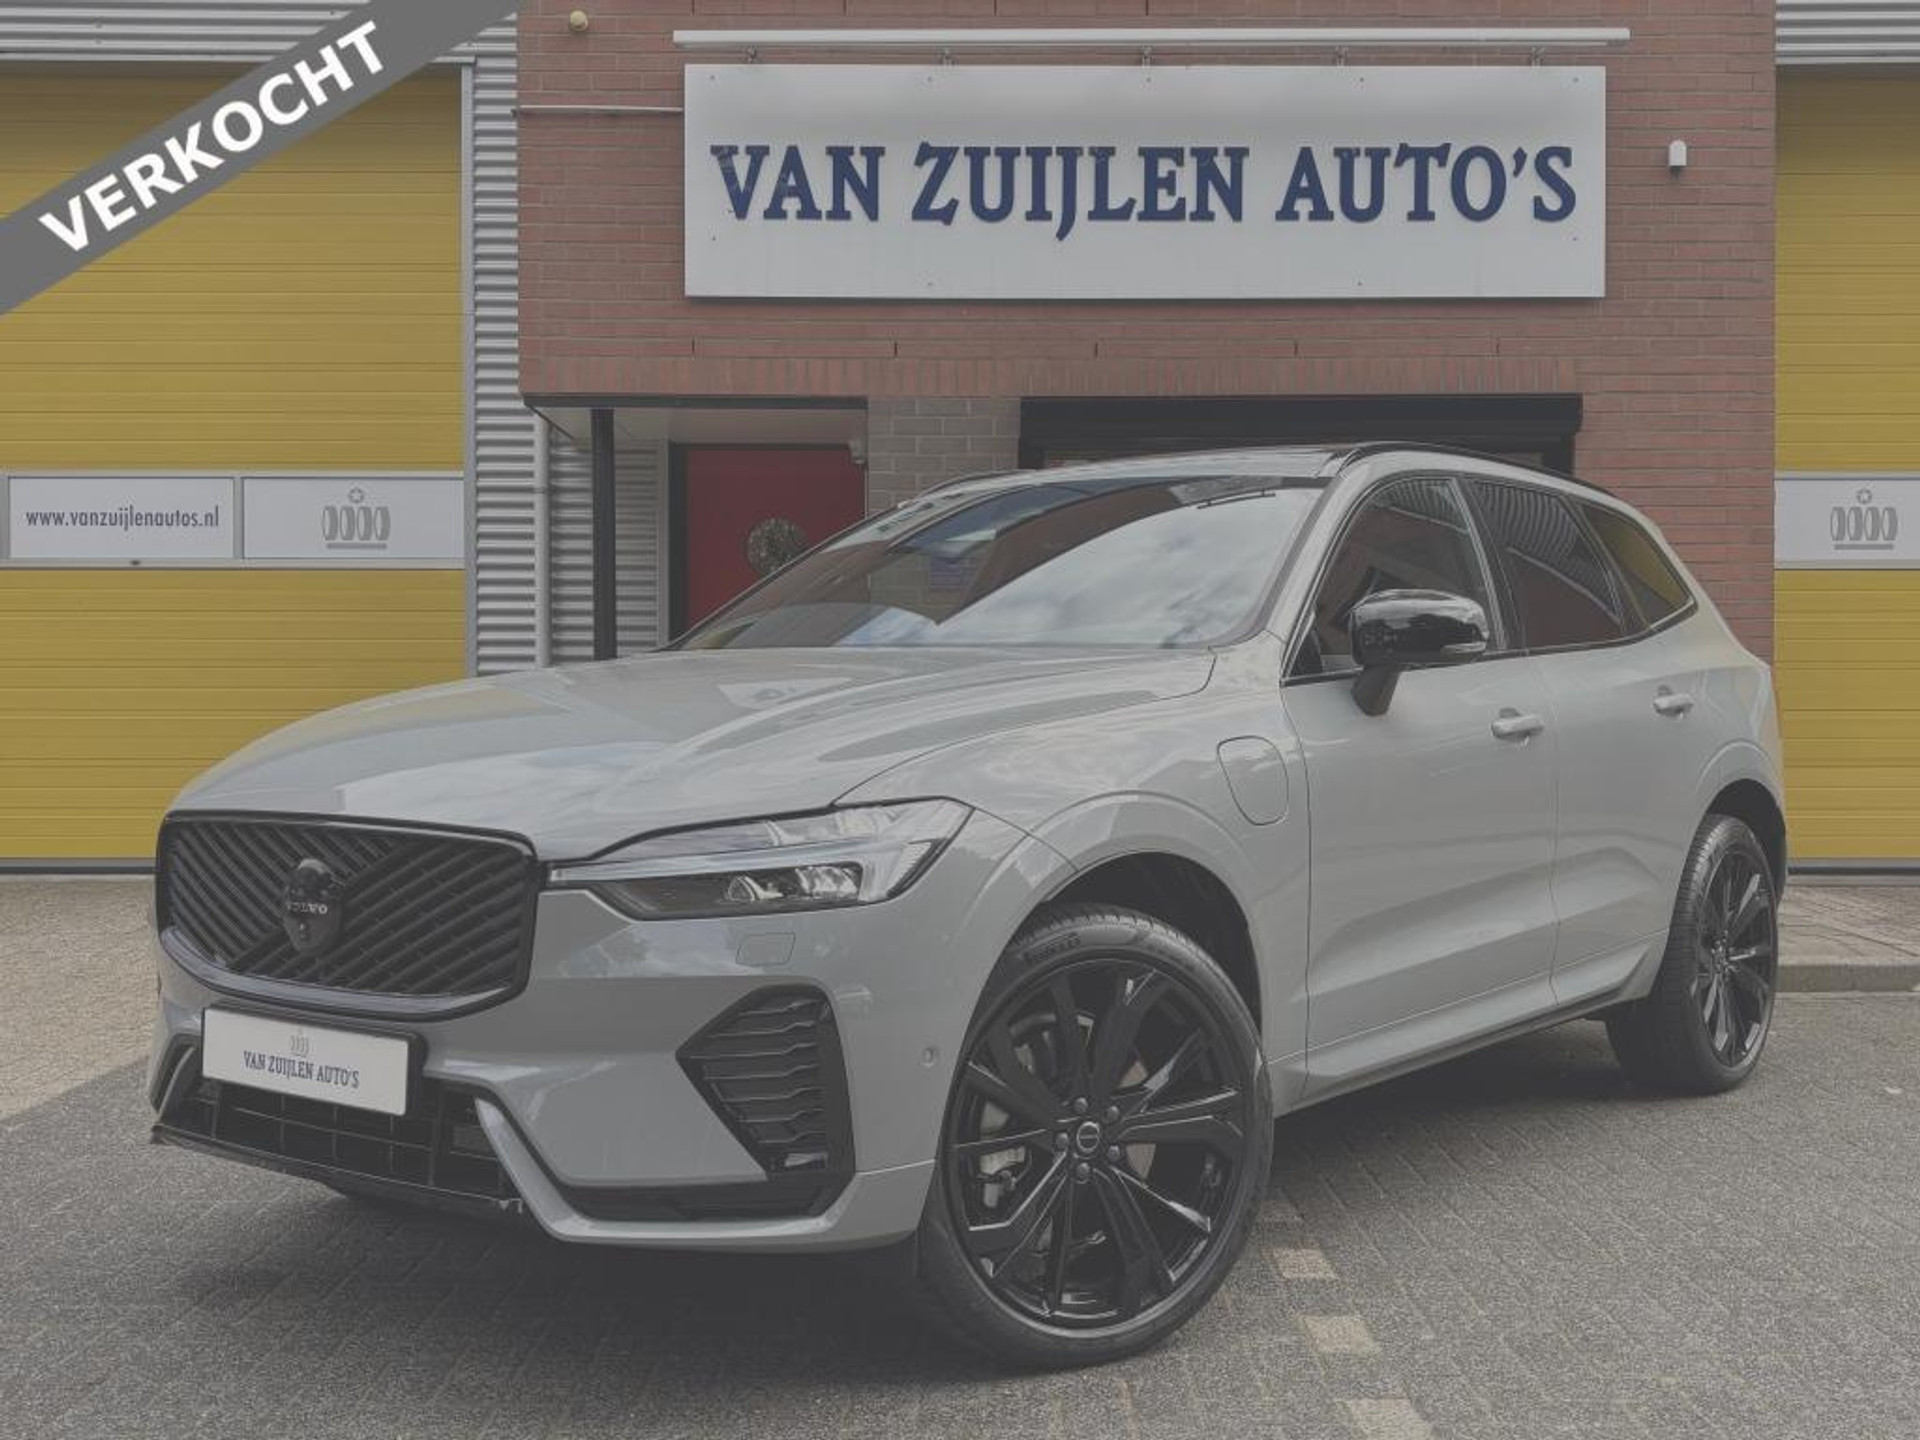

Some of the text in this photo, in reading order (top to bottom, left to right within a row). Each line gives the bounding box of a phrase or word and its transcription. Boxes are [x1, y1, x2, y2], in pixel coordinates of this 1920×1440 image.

[710, 141, 1577, 241] VAN ZUIJLEN AUTO'S
[26, 505, 219, 531] www.vanzuijlenautos.nl
[243, 1050, 359, 1088] VAN ZUIJLEN AUTO'S
